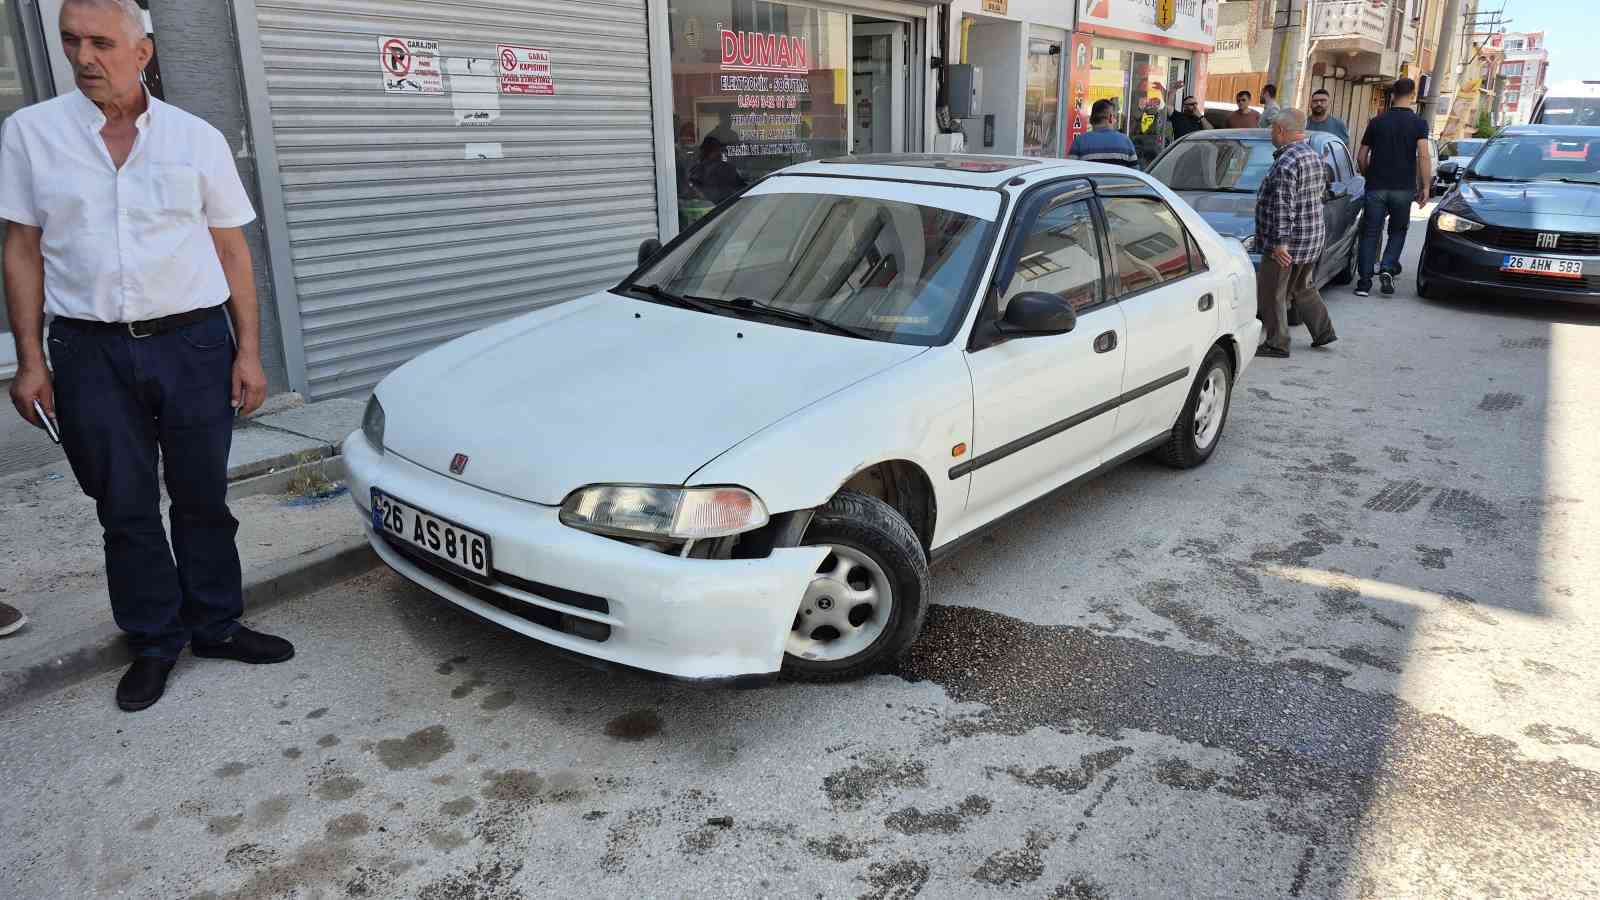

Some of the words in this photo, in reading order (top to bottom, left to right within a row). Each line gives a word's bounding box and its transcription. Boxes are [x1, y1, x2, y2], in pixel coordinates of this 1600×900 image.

[407, 40, 438, 50] GARAJDIR
[720, 30, 808, 68] DUMAN
[528, 52, 548, 61] GARAJ
[519, 63, 549, 72] KAPISIDIR
[503, 73, 520, 83] PARK
[720, 74, 768, 92] ELEKTRONİK
[1536, 233, 1560, 248] FIAT
[1510, 257, 1524, 268] 26
[1530, 259, 1552, 271] AHN
[383, 500, 403, 535] 26
